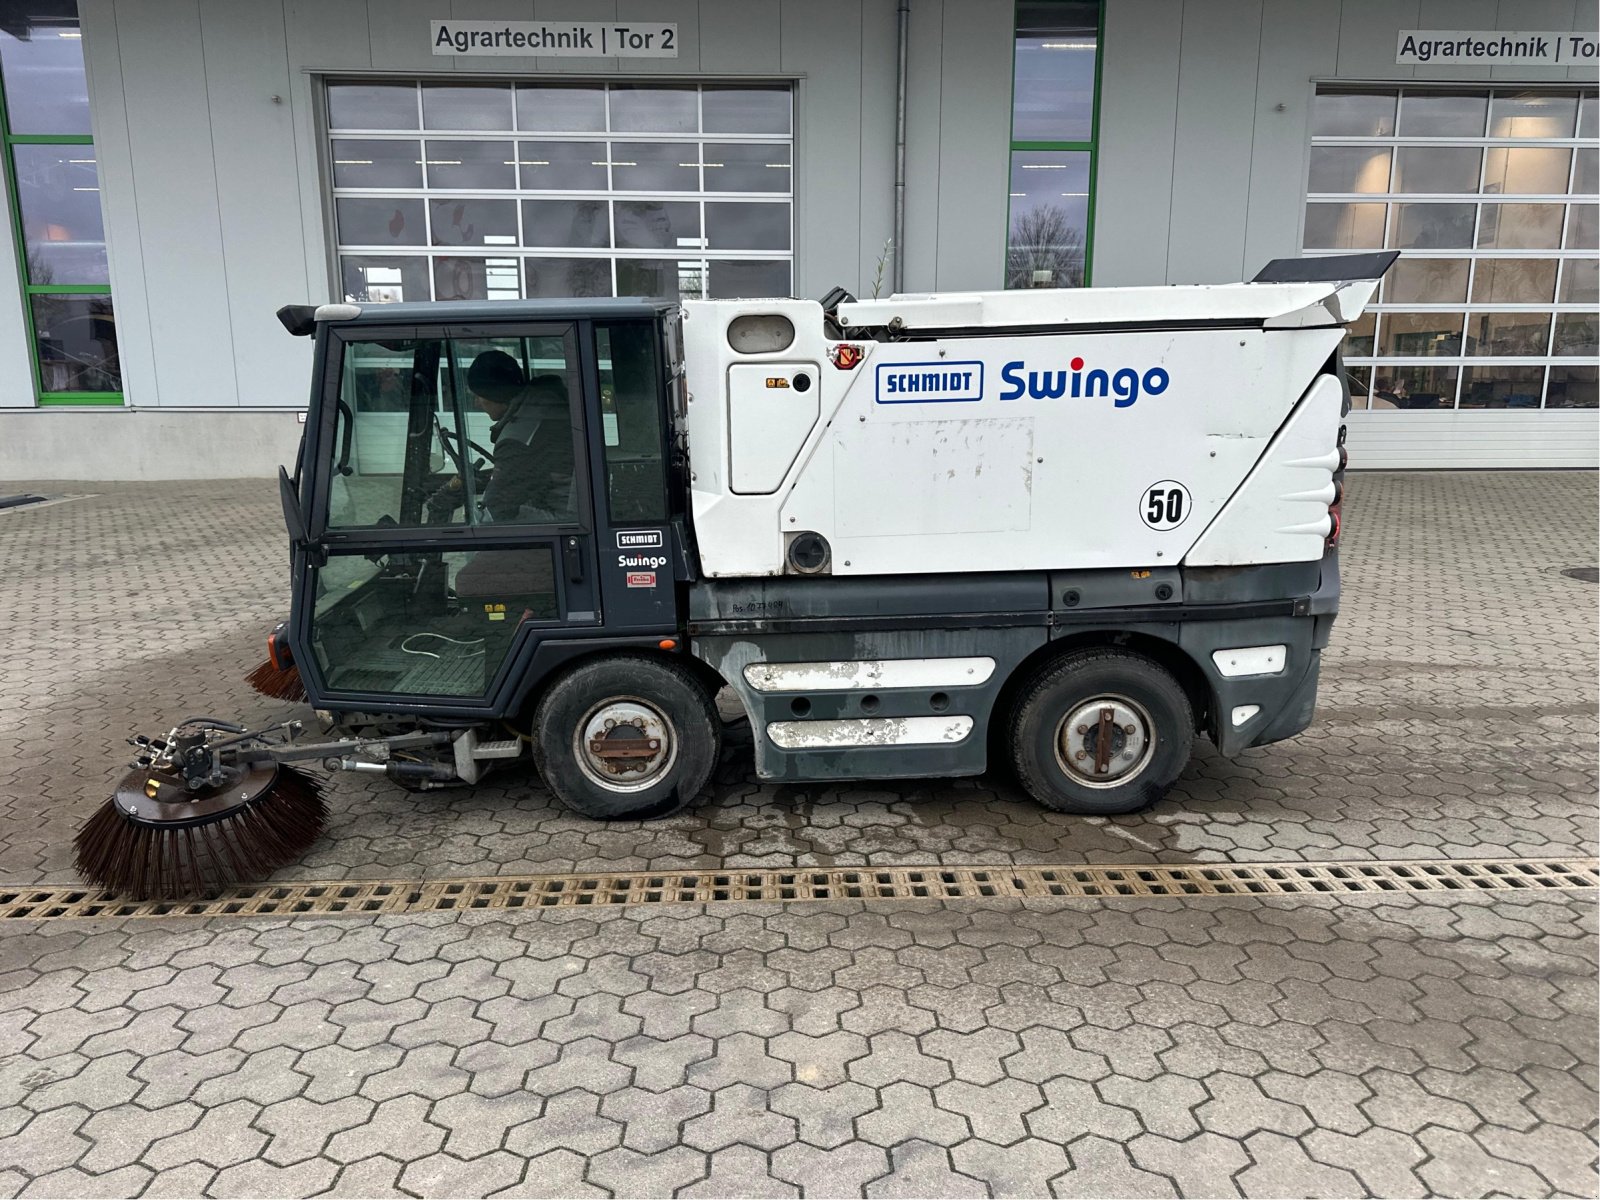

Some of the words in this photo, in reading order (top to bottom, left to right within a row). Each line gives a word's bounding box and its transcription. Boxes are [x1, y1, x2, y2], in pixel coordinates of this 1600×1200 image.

[436, 25, 593, 52] Agrartechnik
[614, 28, 653, 49] Tor
[661, 28, 674, 49] 2
[1400, 36, 1548, 61] Agrartechnik
[887, 372, 972, 392] SCHMIDT
[1000, 357, 1169, 408] Swingo
[1147, 488, 1183, 524] 50
[621, 535, 657, 544] SCHMIDT
[618, 554, 667, 569] Swingo
